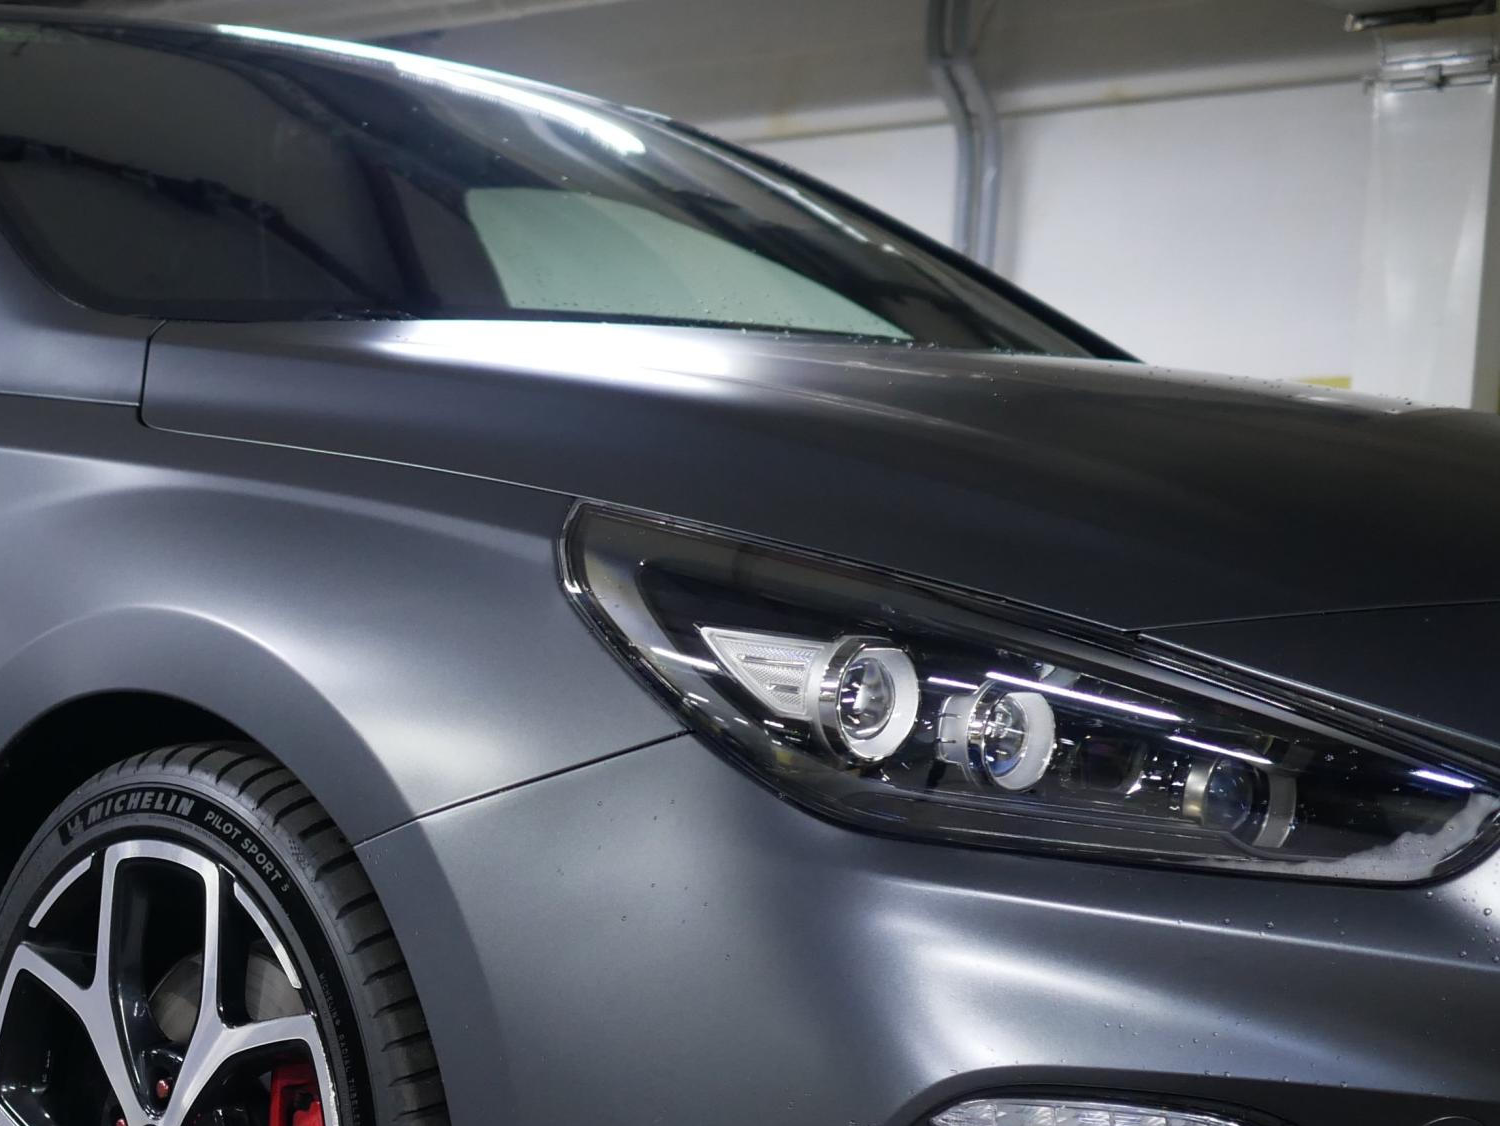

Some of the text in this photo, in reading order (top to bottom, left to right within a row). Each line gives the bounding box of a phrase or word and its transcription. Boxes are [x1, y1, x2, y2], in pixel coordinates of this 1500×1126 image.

[88, 792, 195, 822] MICHELIN
[204, 811, 242, 840] PILOT
[241, 838, 282, 881] SPORT
